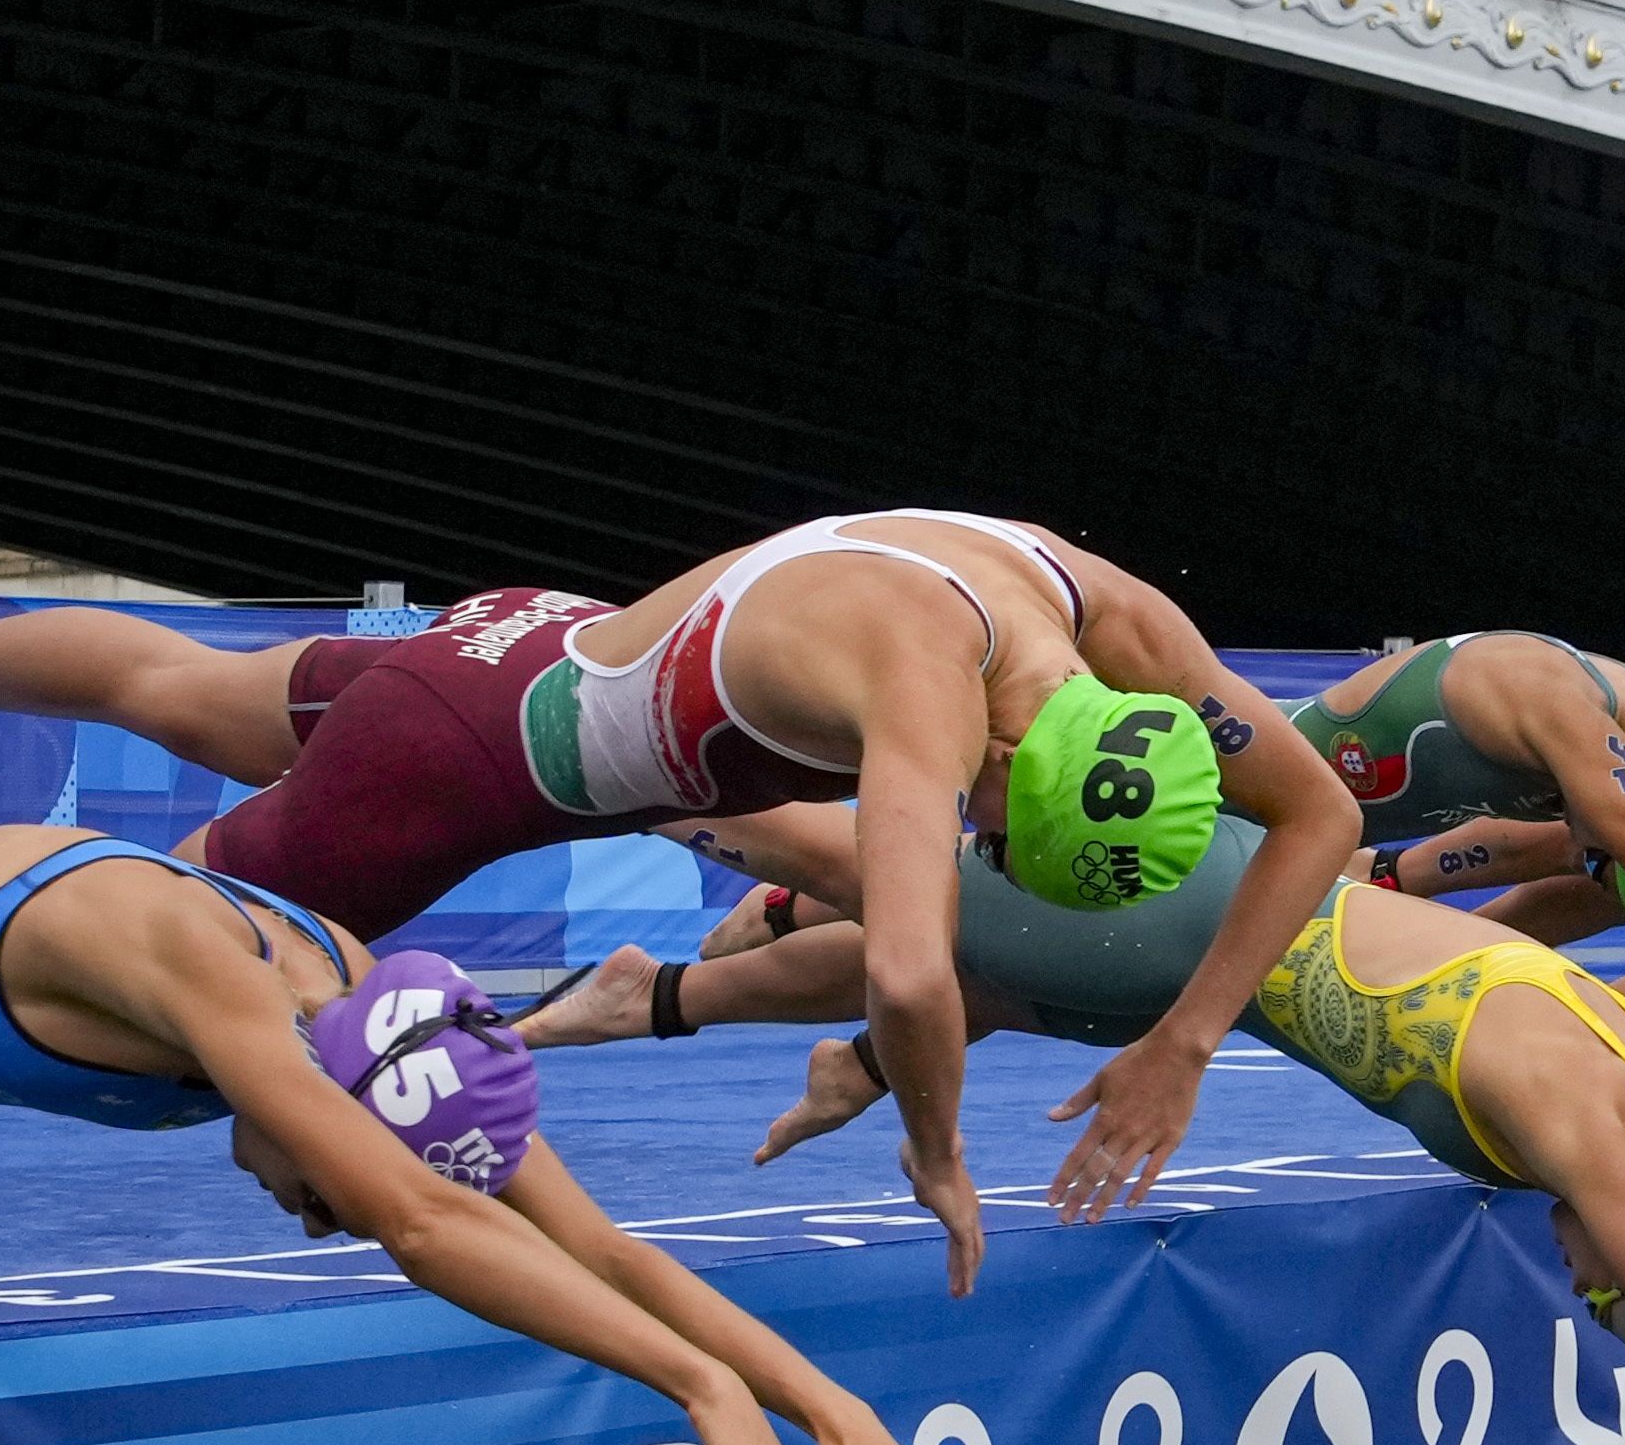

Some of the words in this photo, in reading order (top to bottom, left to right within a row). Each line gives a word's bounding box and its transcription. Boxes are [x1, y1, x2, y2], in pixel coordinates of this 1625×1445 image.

[1081, 710, 1178, 823] 48
[1437, 843, 1492, 876] 28
[364, 988, 464, 1127] 55
